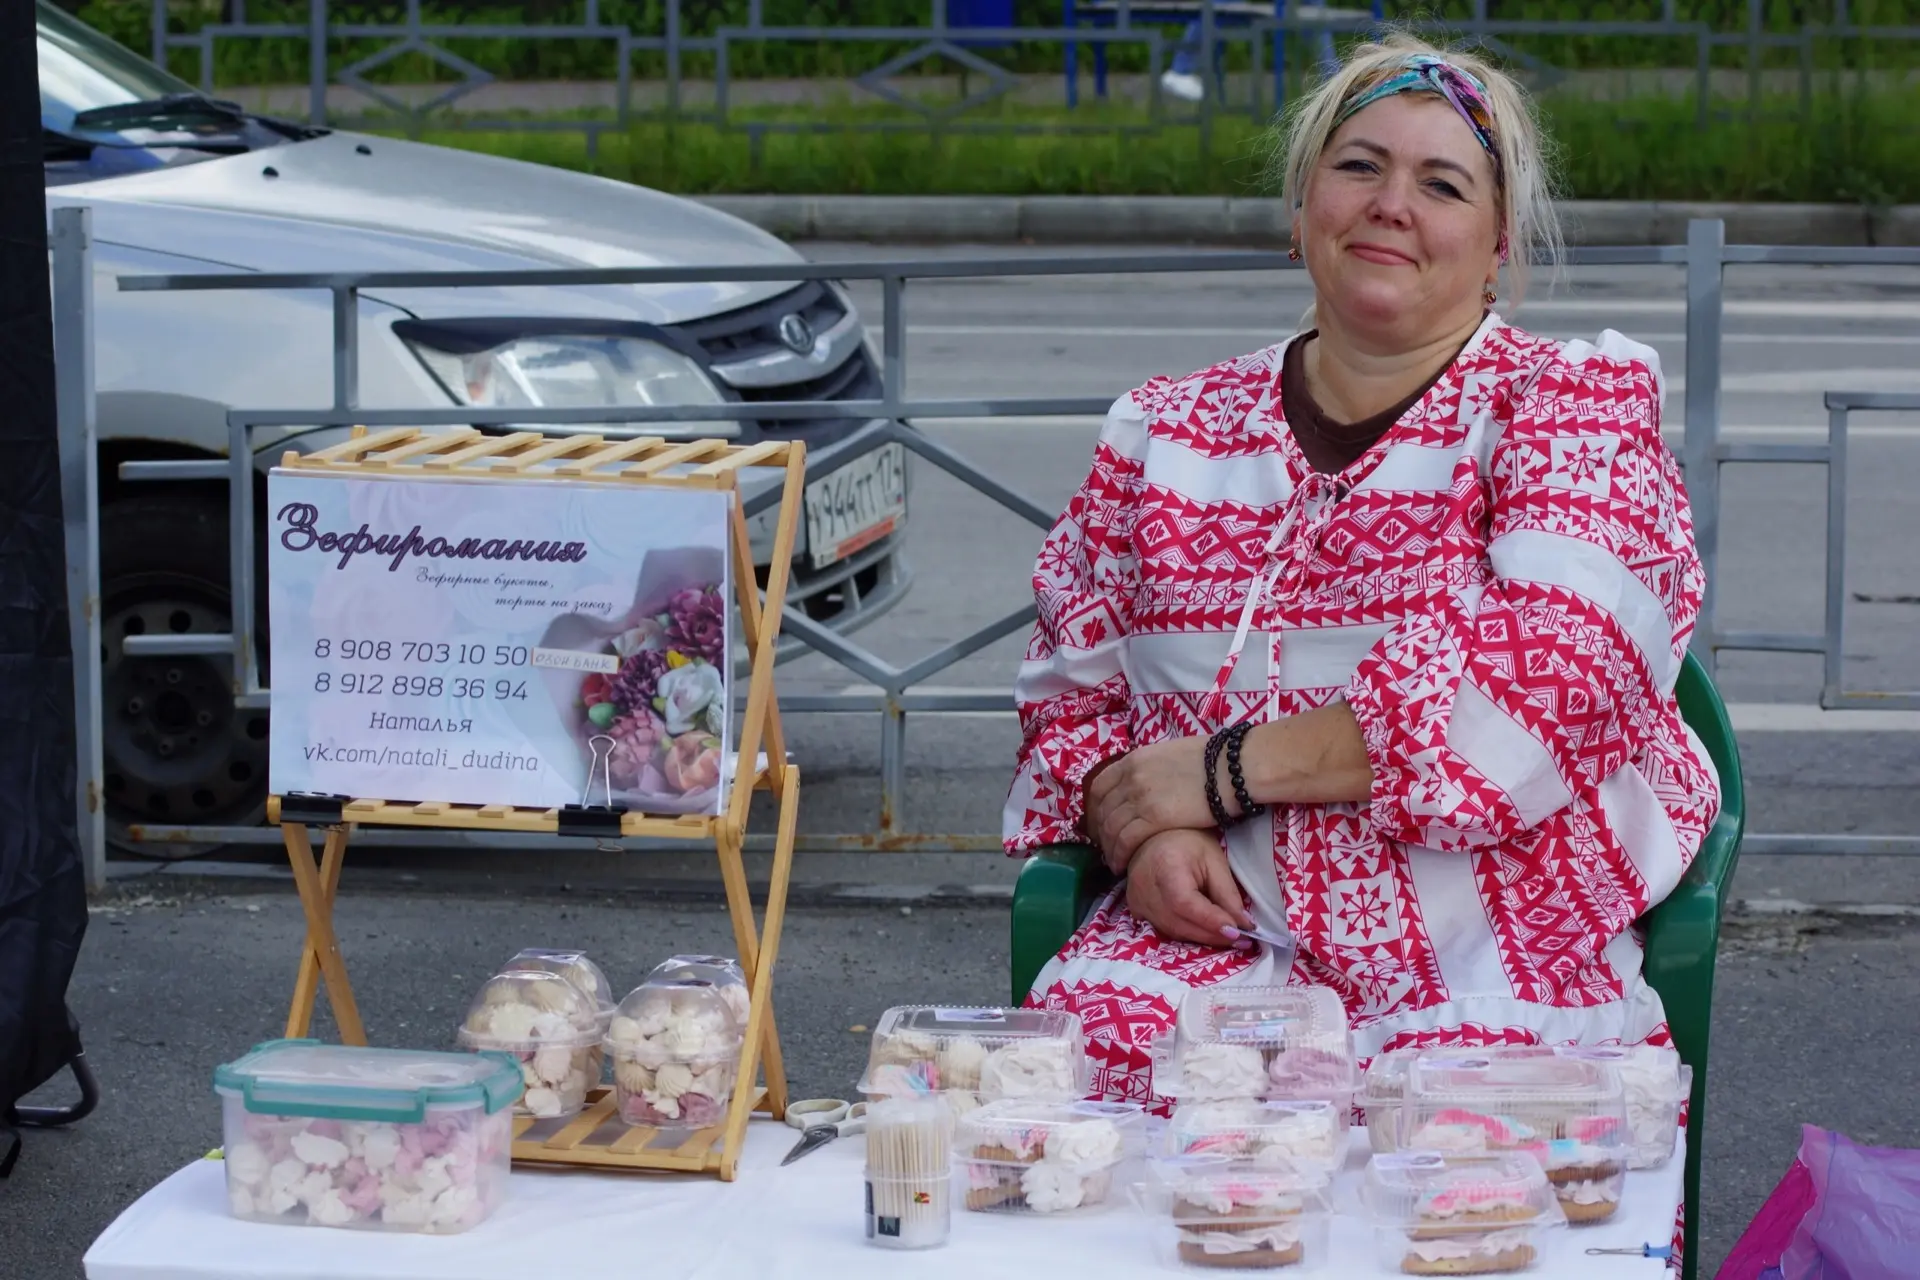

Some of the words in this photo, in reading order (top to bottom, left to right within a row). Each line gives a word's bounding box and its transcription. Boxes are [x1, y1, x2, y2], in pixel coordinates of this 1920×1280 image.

[277, 503, 587, 571] Зефиромания
[415, 566, 490, 588] Зефирные
[493, 572, 554, 590] букеты,
[494, 595, 547, 611] торты
[551, 600, 569, 609] на
[570, 600, 614, 613] заказ
[314, 638, 331, 658] 8
[340, 639, 392, 661] 908
[400, 641, 450, 663] 703
[457, 644, 485, 665] 10
[494, 646, 527, 666] 50
[535, 653, 570, 666] ОЗОН
[573, 657, 611, 670] БАНК
[314, 672, 331, 693] 8
[340, 673, 383, 695] 912
[392, 675, 443, 697] 898
[452, 678, 485, 699] 36
[494, 680, 528, 701] 94
[369, 711, 472, 733] Наталья
[303, 743, 538, 772] vk.com/natali_dudina
